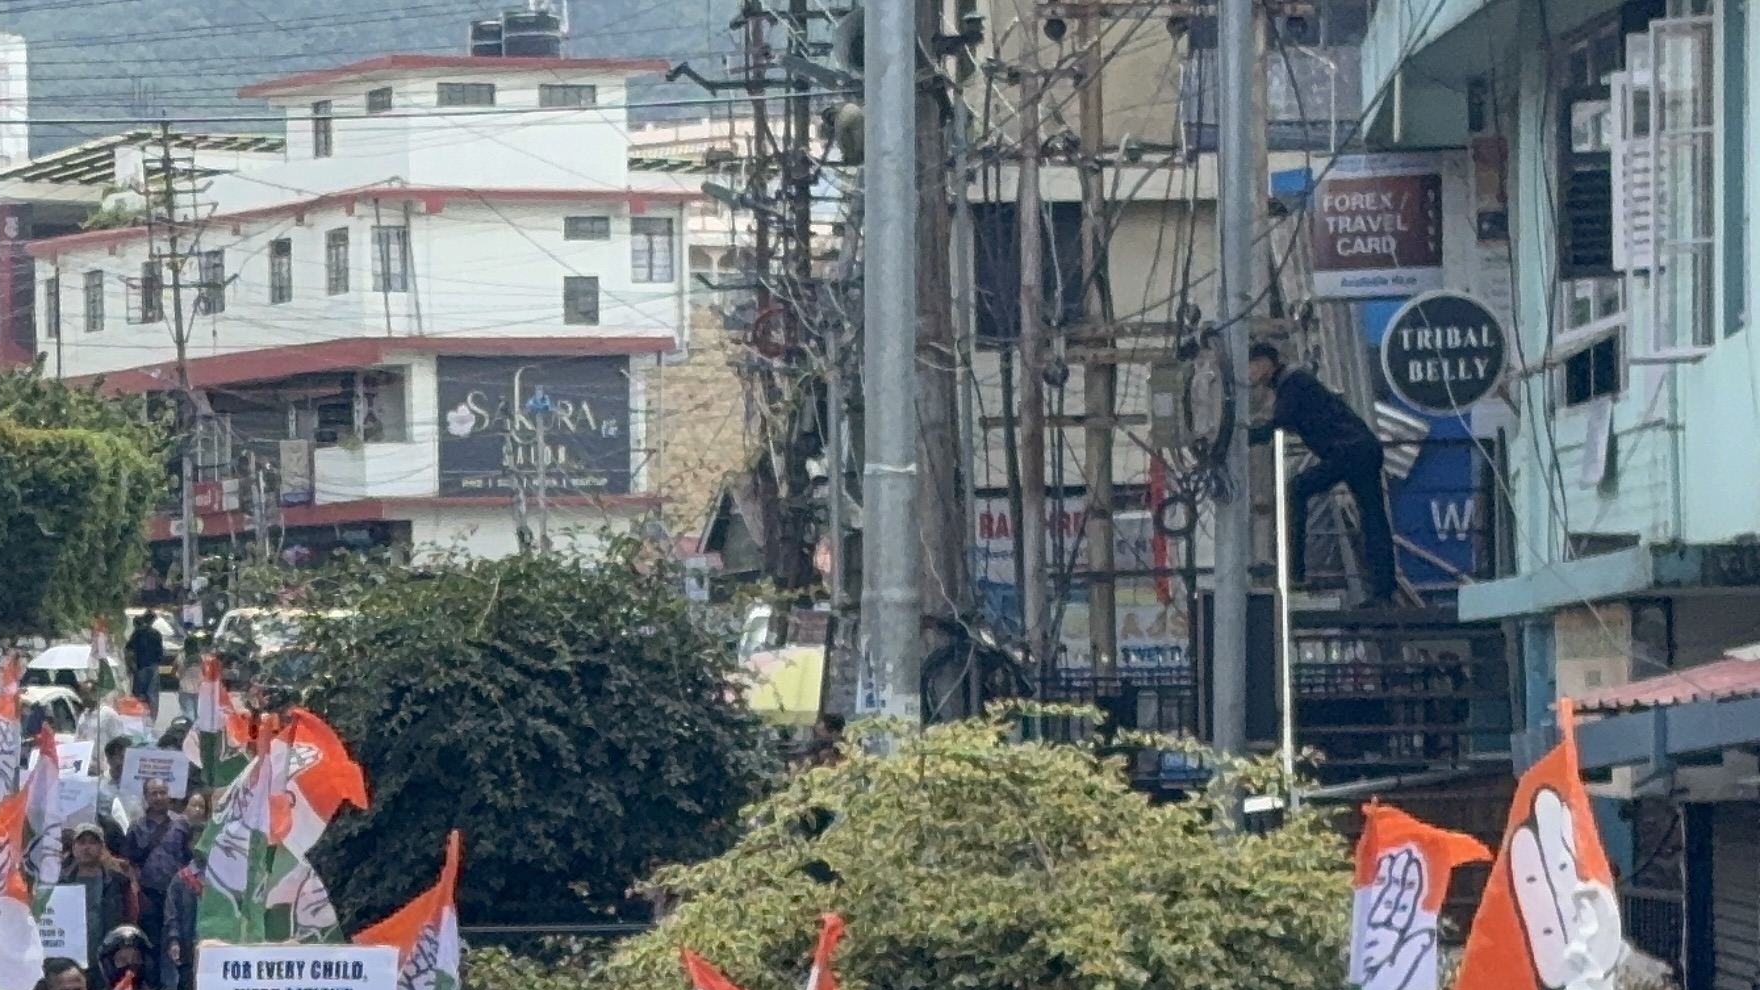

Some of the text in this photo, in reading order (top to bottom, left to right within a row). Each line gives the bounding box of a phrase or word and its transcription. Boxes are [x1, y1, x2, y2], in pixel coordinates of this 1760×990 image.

[1323, 191, 1394, 212] FOREX
[1325, 213, 1409, 234] TRAVEL
[1336, 235, 1397, 257] CARD
[1399, 325, 1495, 351] TRIBAL
[1408, 357, 1490, 383] BELLY
[222, 960, 368, 982] FOR EVERY CHILD,
